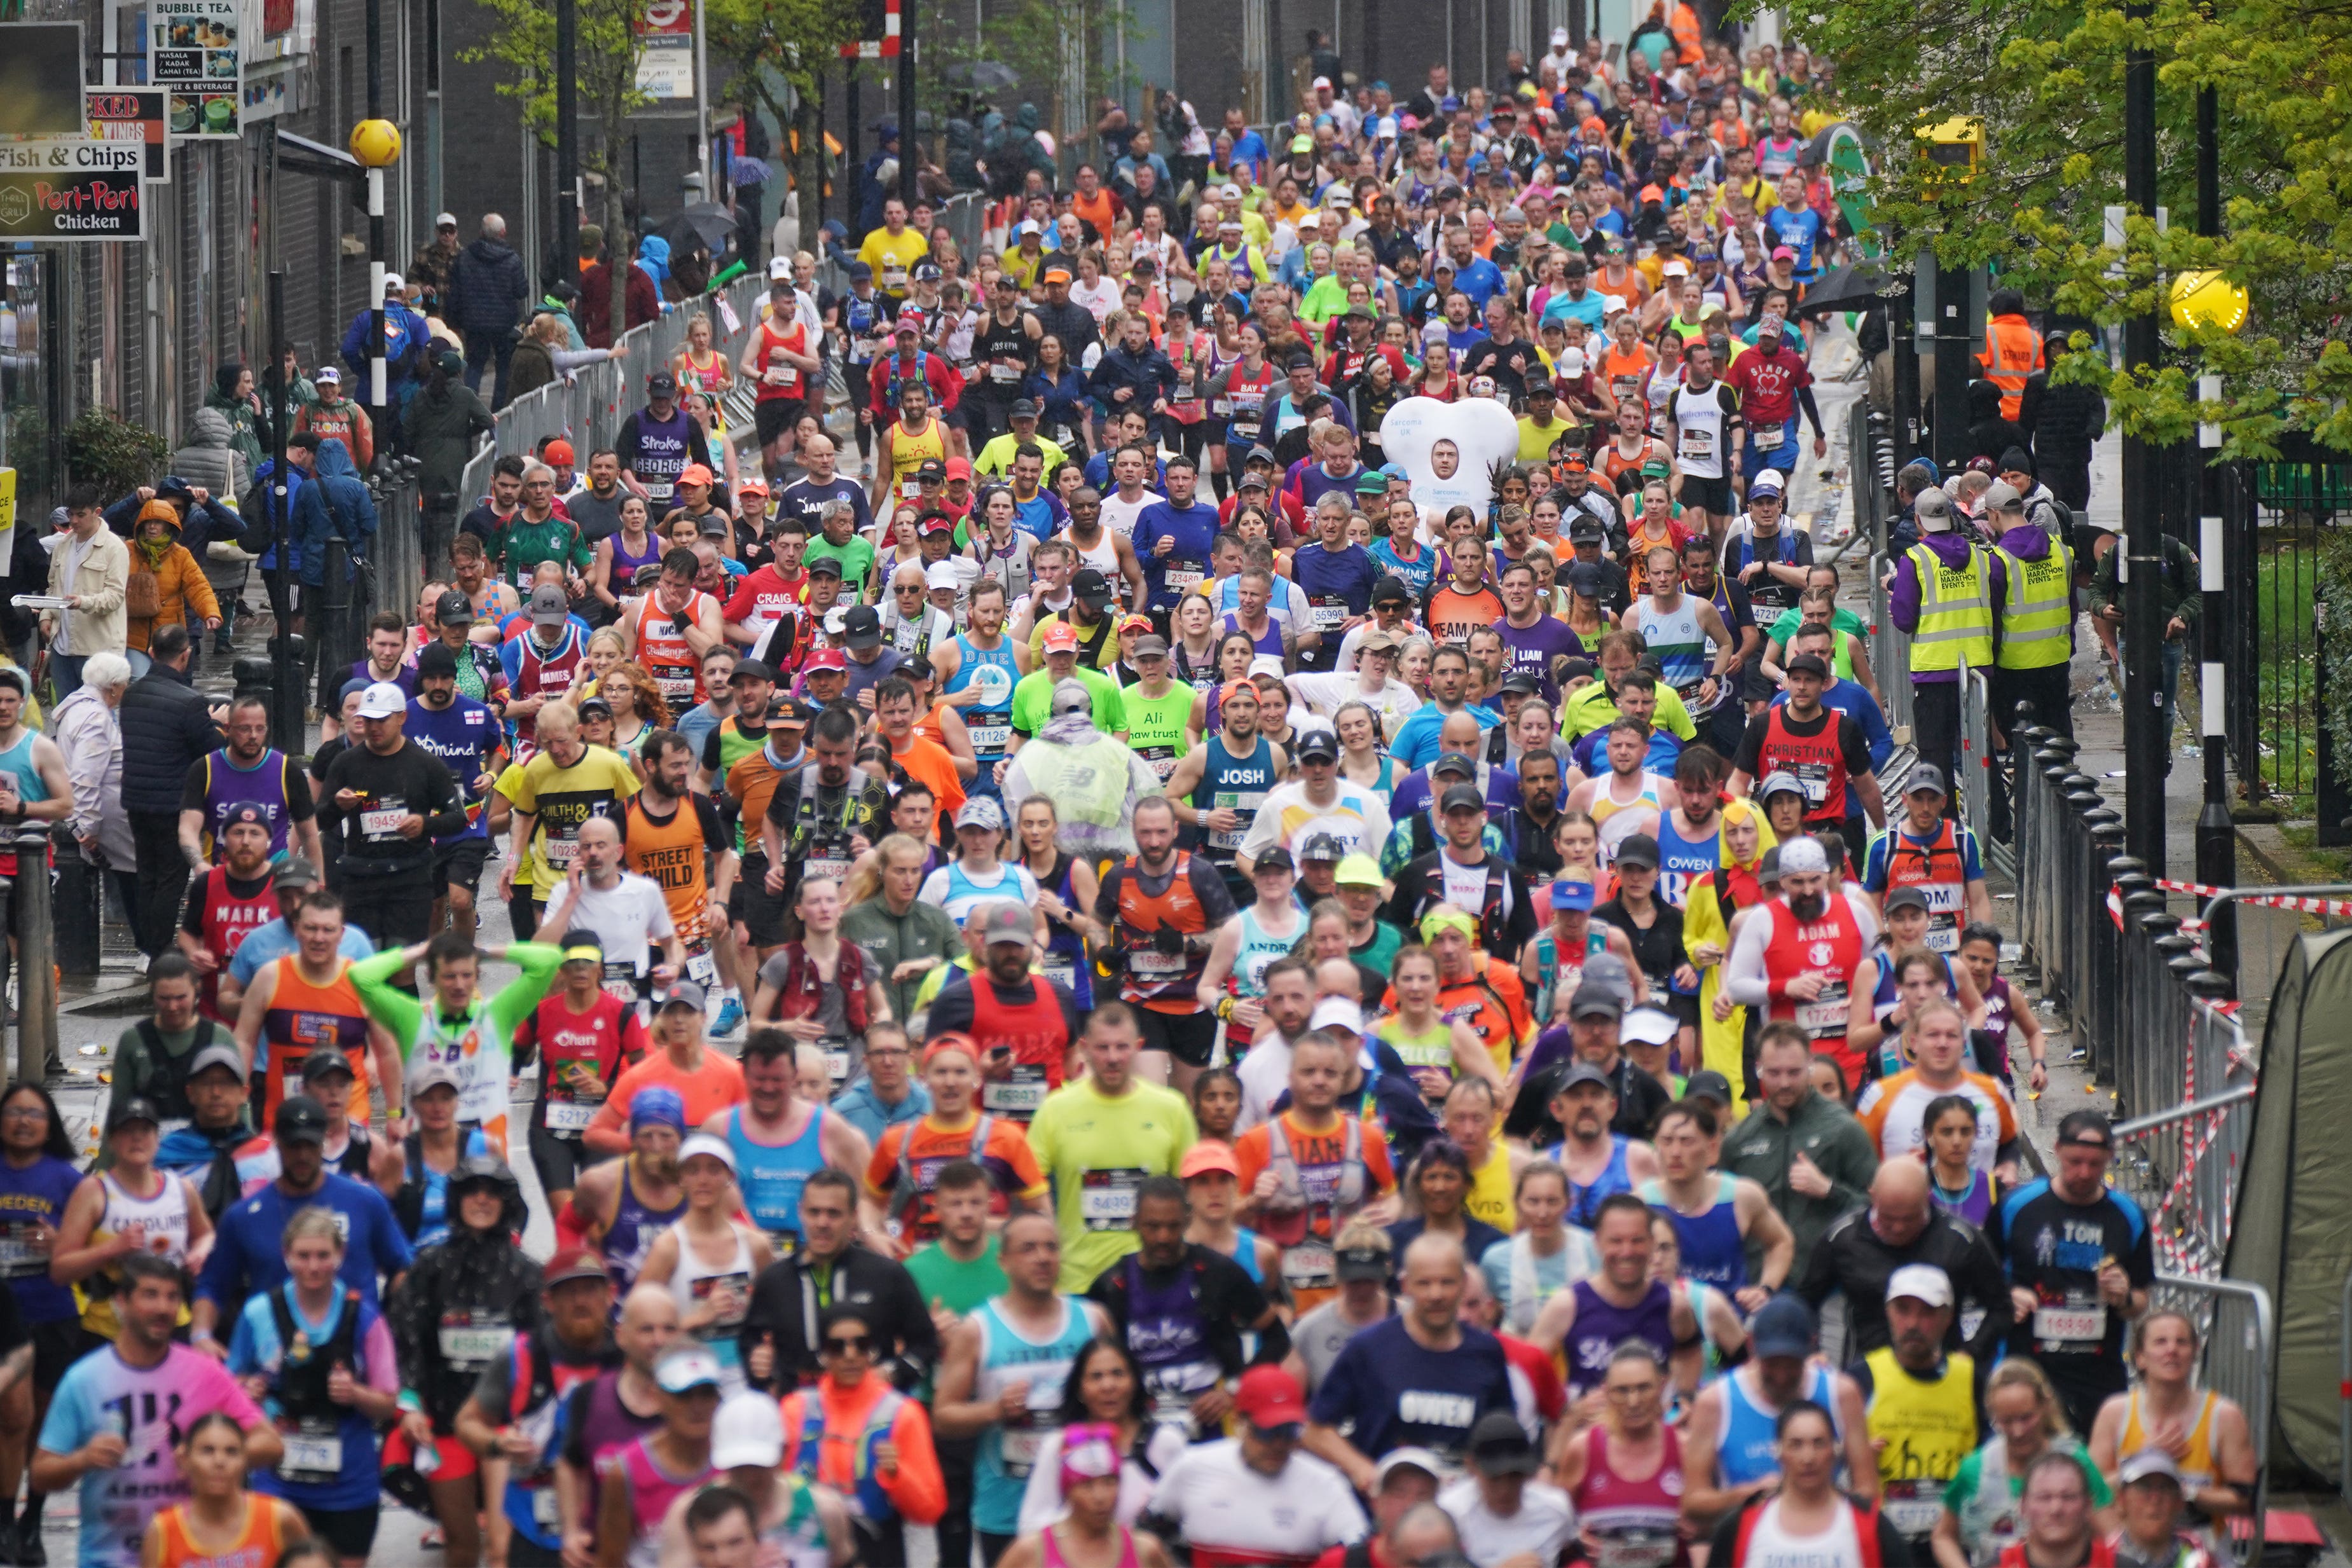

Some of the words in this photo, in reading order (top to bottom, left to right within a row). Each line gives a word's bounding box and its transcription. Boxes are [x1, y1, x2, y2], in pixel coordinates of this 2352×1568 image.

[156, 3, 203, 13] BUBBLE
[209, 3, 233, 13] TEA
[102, 122, 145, 139] WINGS
[0, 148, 40, 167] Fish
[48, 147, 69, 167] &
[76, 146, 137, 170] Chips
[34, 181, 138, 210] Peri-Peri
[54, 214, 120, 229] Chicken
[1751, 364, 1790, 378] SIMON
[1241, 384, 1258, 393] BAY
[230, 421, 253, 435] LORA
[310, 421, 348, 434] FLORA
[641, 436, 682, 450] Stroke
[636, 457, 685, 473] GEORGE
[2025, 562, 2053, 572] LONDON
[2026, 567, 2063, 579] MARATHON
[1940, 574, 1976, 584] MARATHON
[1941, 581, 1965, 590] EVENTS
[2028, 575, 2051, 586] EVENTS
[756, 593, 792, 605] CRAIG
[1316, 610, 1344, 621] 55999
[646, 643, 692, 659] Challengers
[966, 651, 1008, 664] DAVE
[1518, 650, 1542, 661] LIAM
[1144, 712, 1163, 724] Ali
[973, 731, 1005, 742] 61126
[1153, 730, 1179, 739] trust
[434, 742, 476, 757] mind
[1766, 743, 1834, 759] CHRISTIAN
[1219, 770, 1264, 784] JOSH
[217, 804, 279, 820] SCPE
[575, 804, 589, 821] &
[641, 848, 692, 868] STREET
[1668, 858, 1713, 870] OWEN
[216, 906, 270, 923] MARK
[1798, 925, 1841, 942] ADAM
[113, 1215, 187, 1233] CAOLINE
